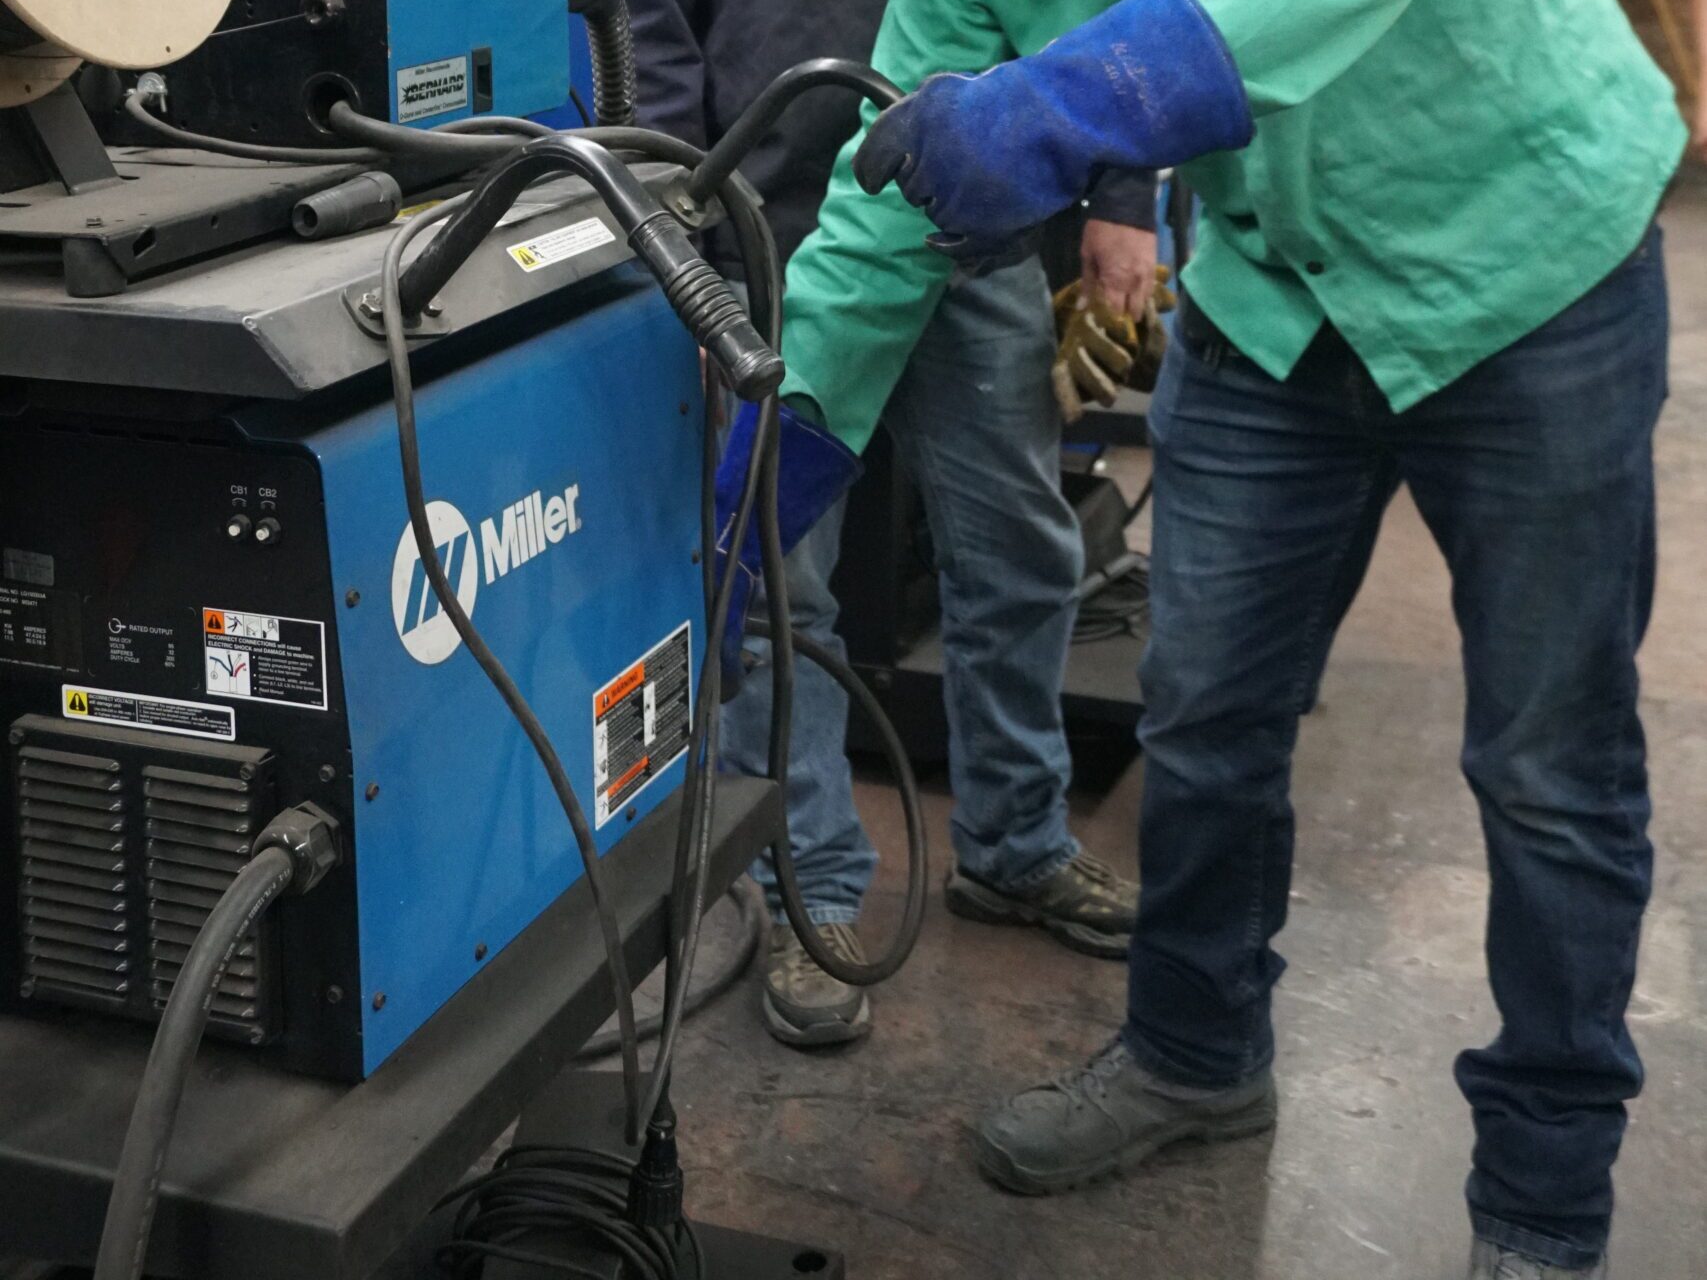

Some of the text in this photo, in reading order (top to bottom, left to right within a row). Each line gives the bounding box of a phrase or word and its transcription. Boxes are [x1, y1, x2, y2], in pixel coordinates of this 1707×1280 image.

[406, 73, 465, 104] BERNARD
[230, 484, 248, 495] CB1
[258, 487, 277, 498] CB2
[480, 483, 581, 585] Miller
[129, 624, 173, 635] RATED OUTPUT
[208, 634, 238, 643] INCORRECT
[238, 638, 276, 648] CONNECTIONS
[110, 649, 133, 657] AMPERES
[208, 641, 233, 649] ELECTRIC
[263, 648, 286, 656] DAMAGE
